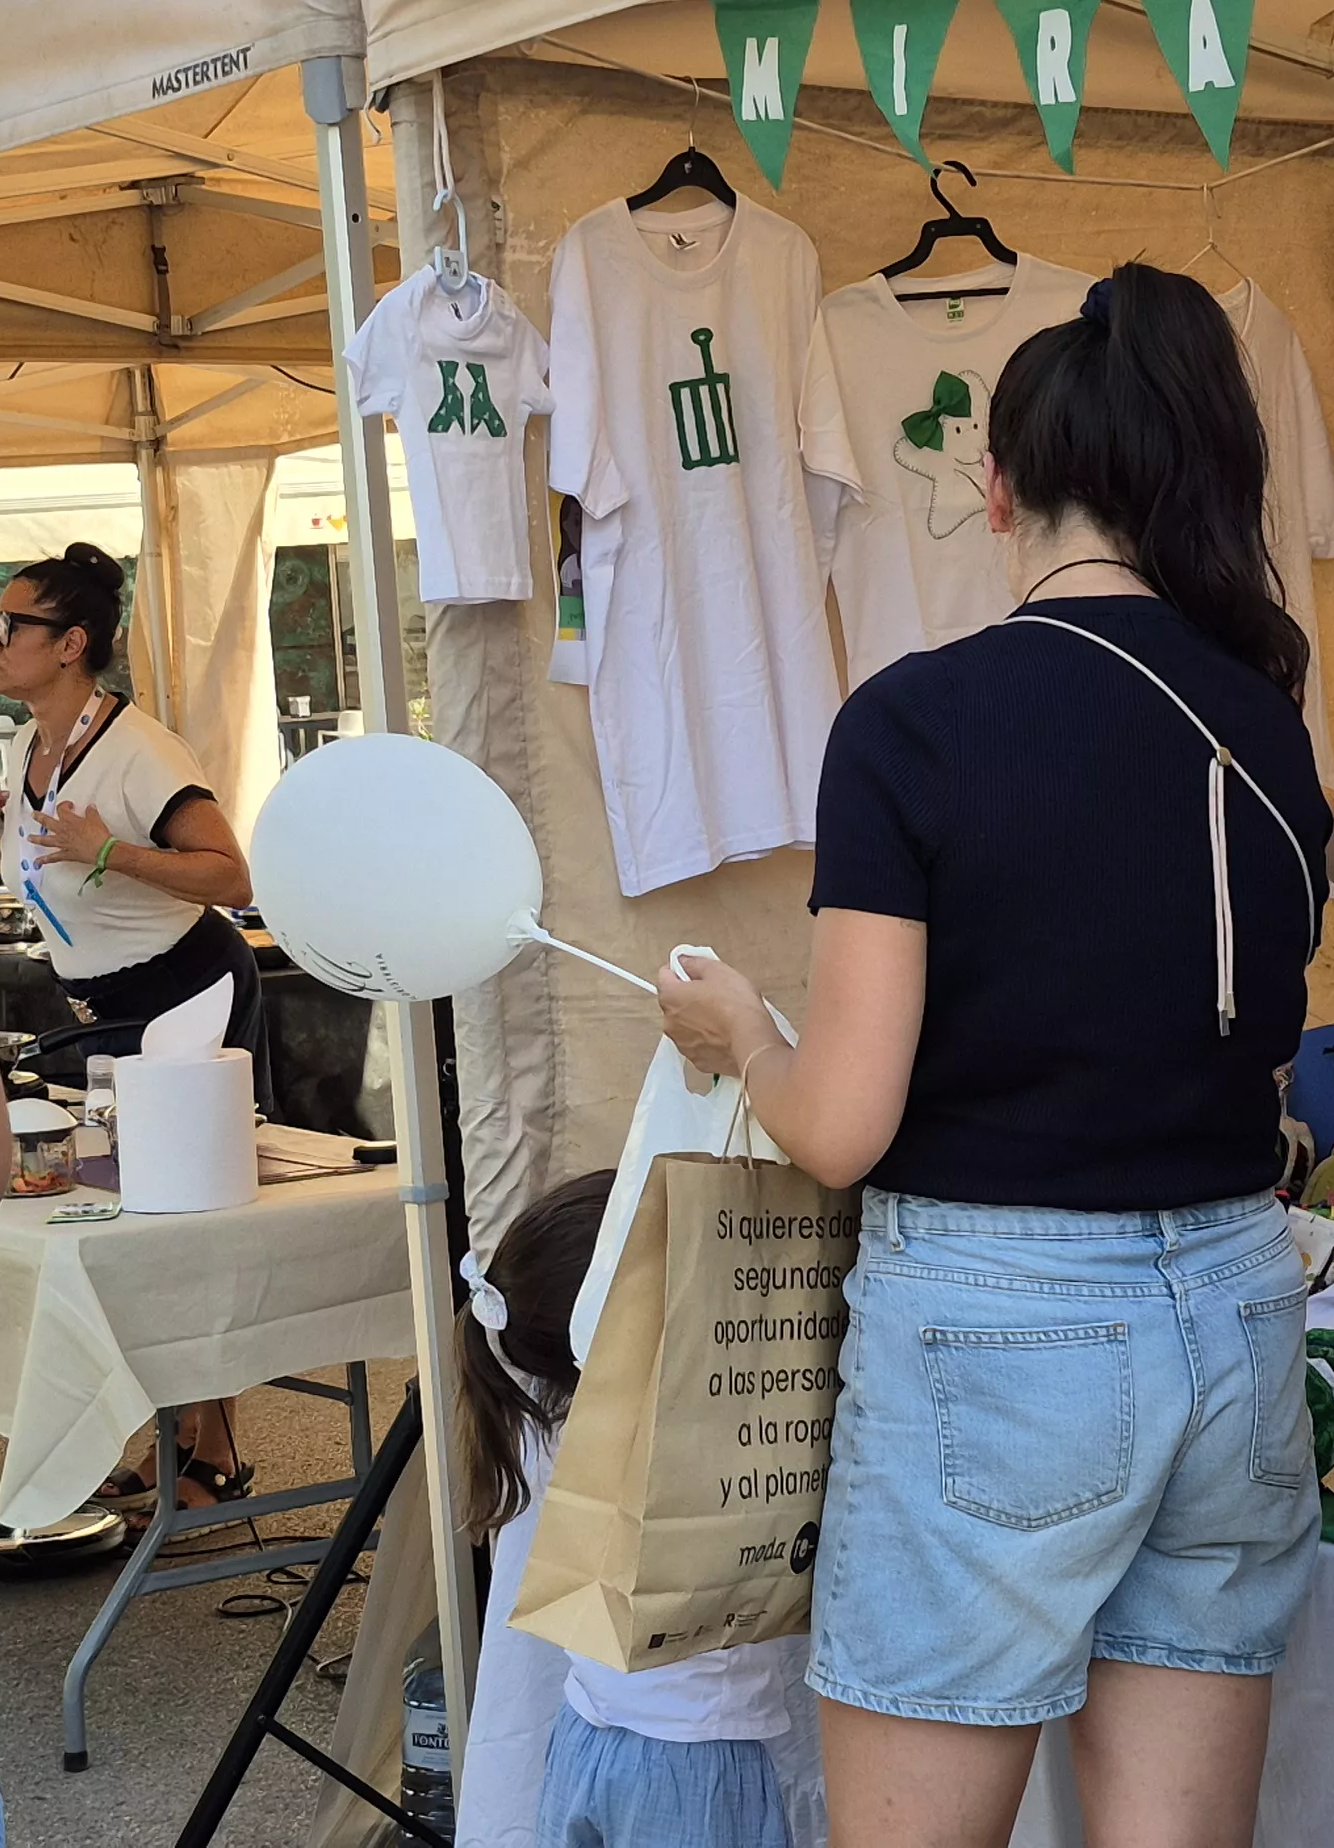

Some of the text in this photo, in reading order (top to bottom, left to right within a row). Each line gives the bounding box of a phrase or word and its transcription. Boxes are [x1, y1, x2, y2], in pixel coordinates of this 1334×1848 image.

[152, 47, 252, 99] MASTERTENT
[717, 1209, 733, 1240] Si
[739, 1210, 826, 1246] quieres
[734, 1260, 841, 1298] segundas
[709, 1366, 842, 1401] a las person
[738, 1423, 752, 1447] a
[759, 1415, 778, 1445] la
[720, 1464, 827, 1508] y al planet
[739, 1536, 787, 1567] moda
